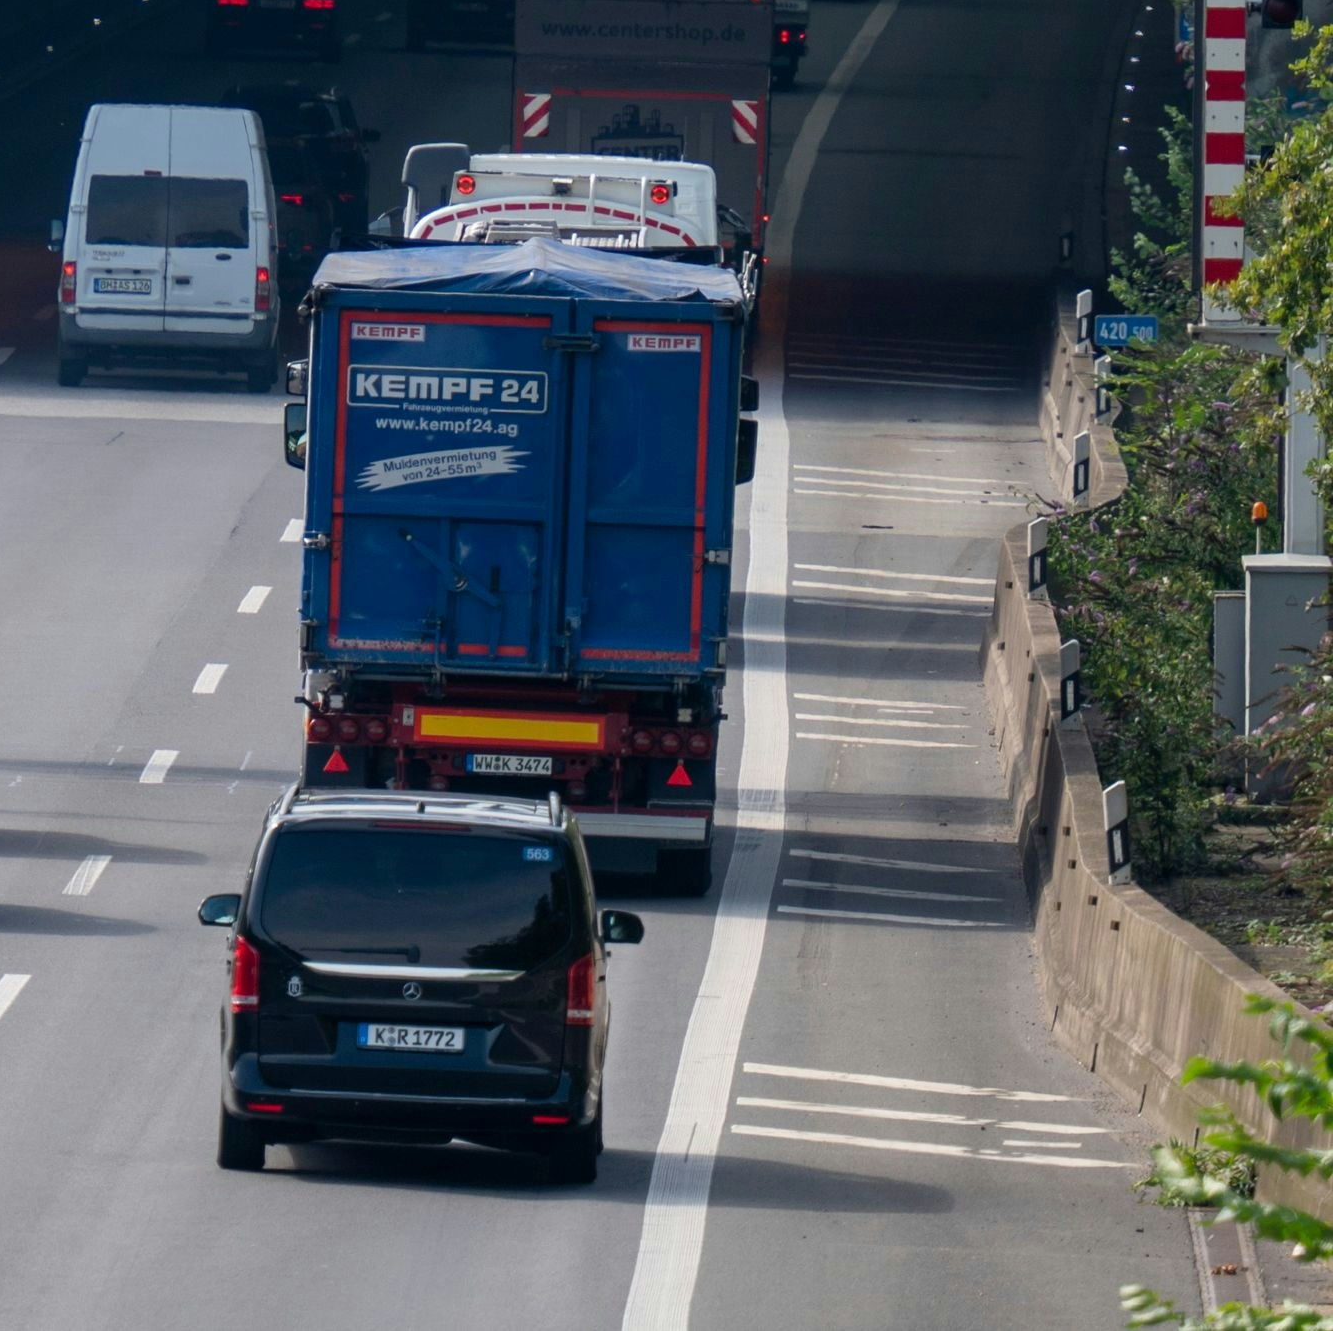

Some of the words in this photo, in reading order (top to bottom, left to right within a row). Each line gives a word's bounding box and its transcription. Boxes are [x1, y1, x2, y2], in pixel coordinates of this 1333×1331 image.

[541, 23, 747, 46] www.centershop.de
[356, 325, 422, 339] KEMPF
[1100, 322, 1128, 340] 420
[632, 336, 697, 349] KEMPF
[356, 373, 494, 401] KEMPF
[501, 379, 539, 403] 24
[402, 401, 489, 415] Fahrzeugvermietung
[376, 417, 518, 437] www.kempf24.ag
[383, 450, 497, 472] Muldenvermietung
[402, 469, 423, 482] von
[475, 755, 493, 770] WW
[502, 757, 511, 771] K
[515, 757, 550, 772] 3474
[527, 848, 550, 860] 563
[375, 1027, 385, 1044] K
[397, 1029, 408, 1045] R
[412, 1030, 455, 1047] 1772
